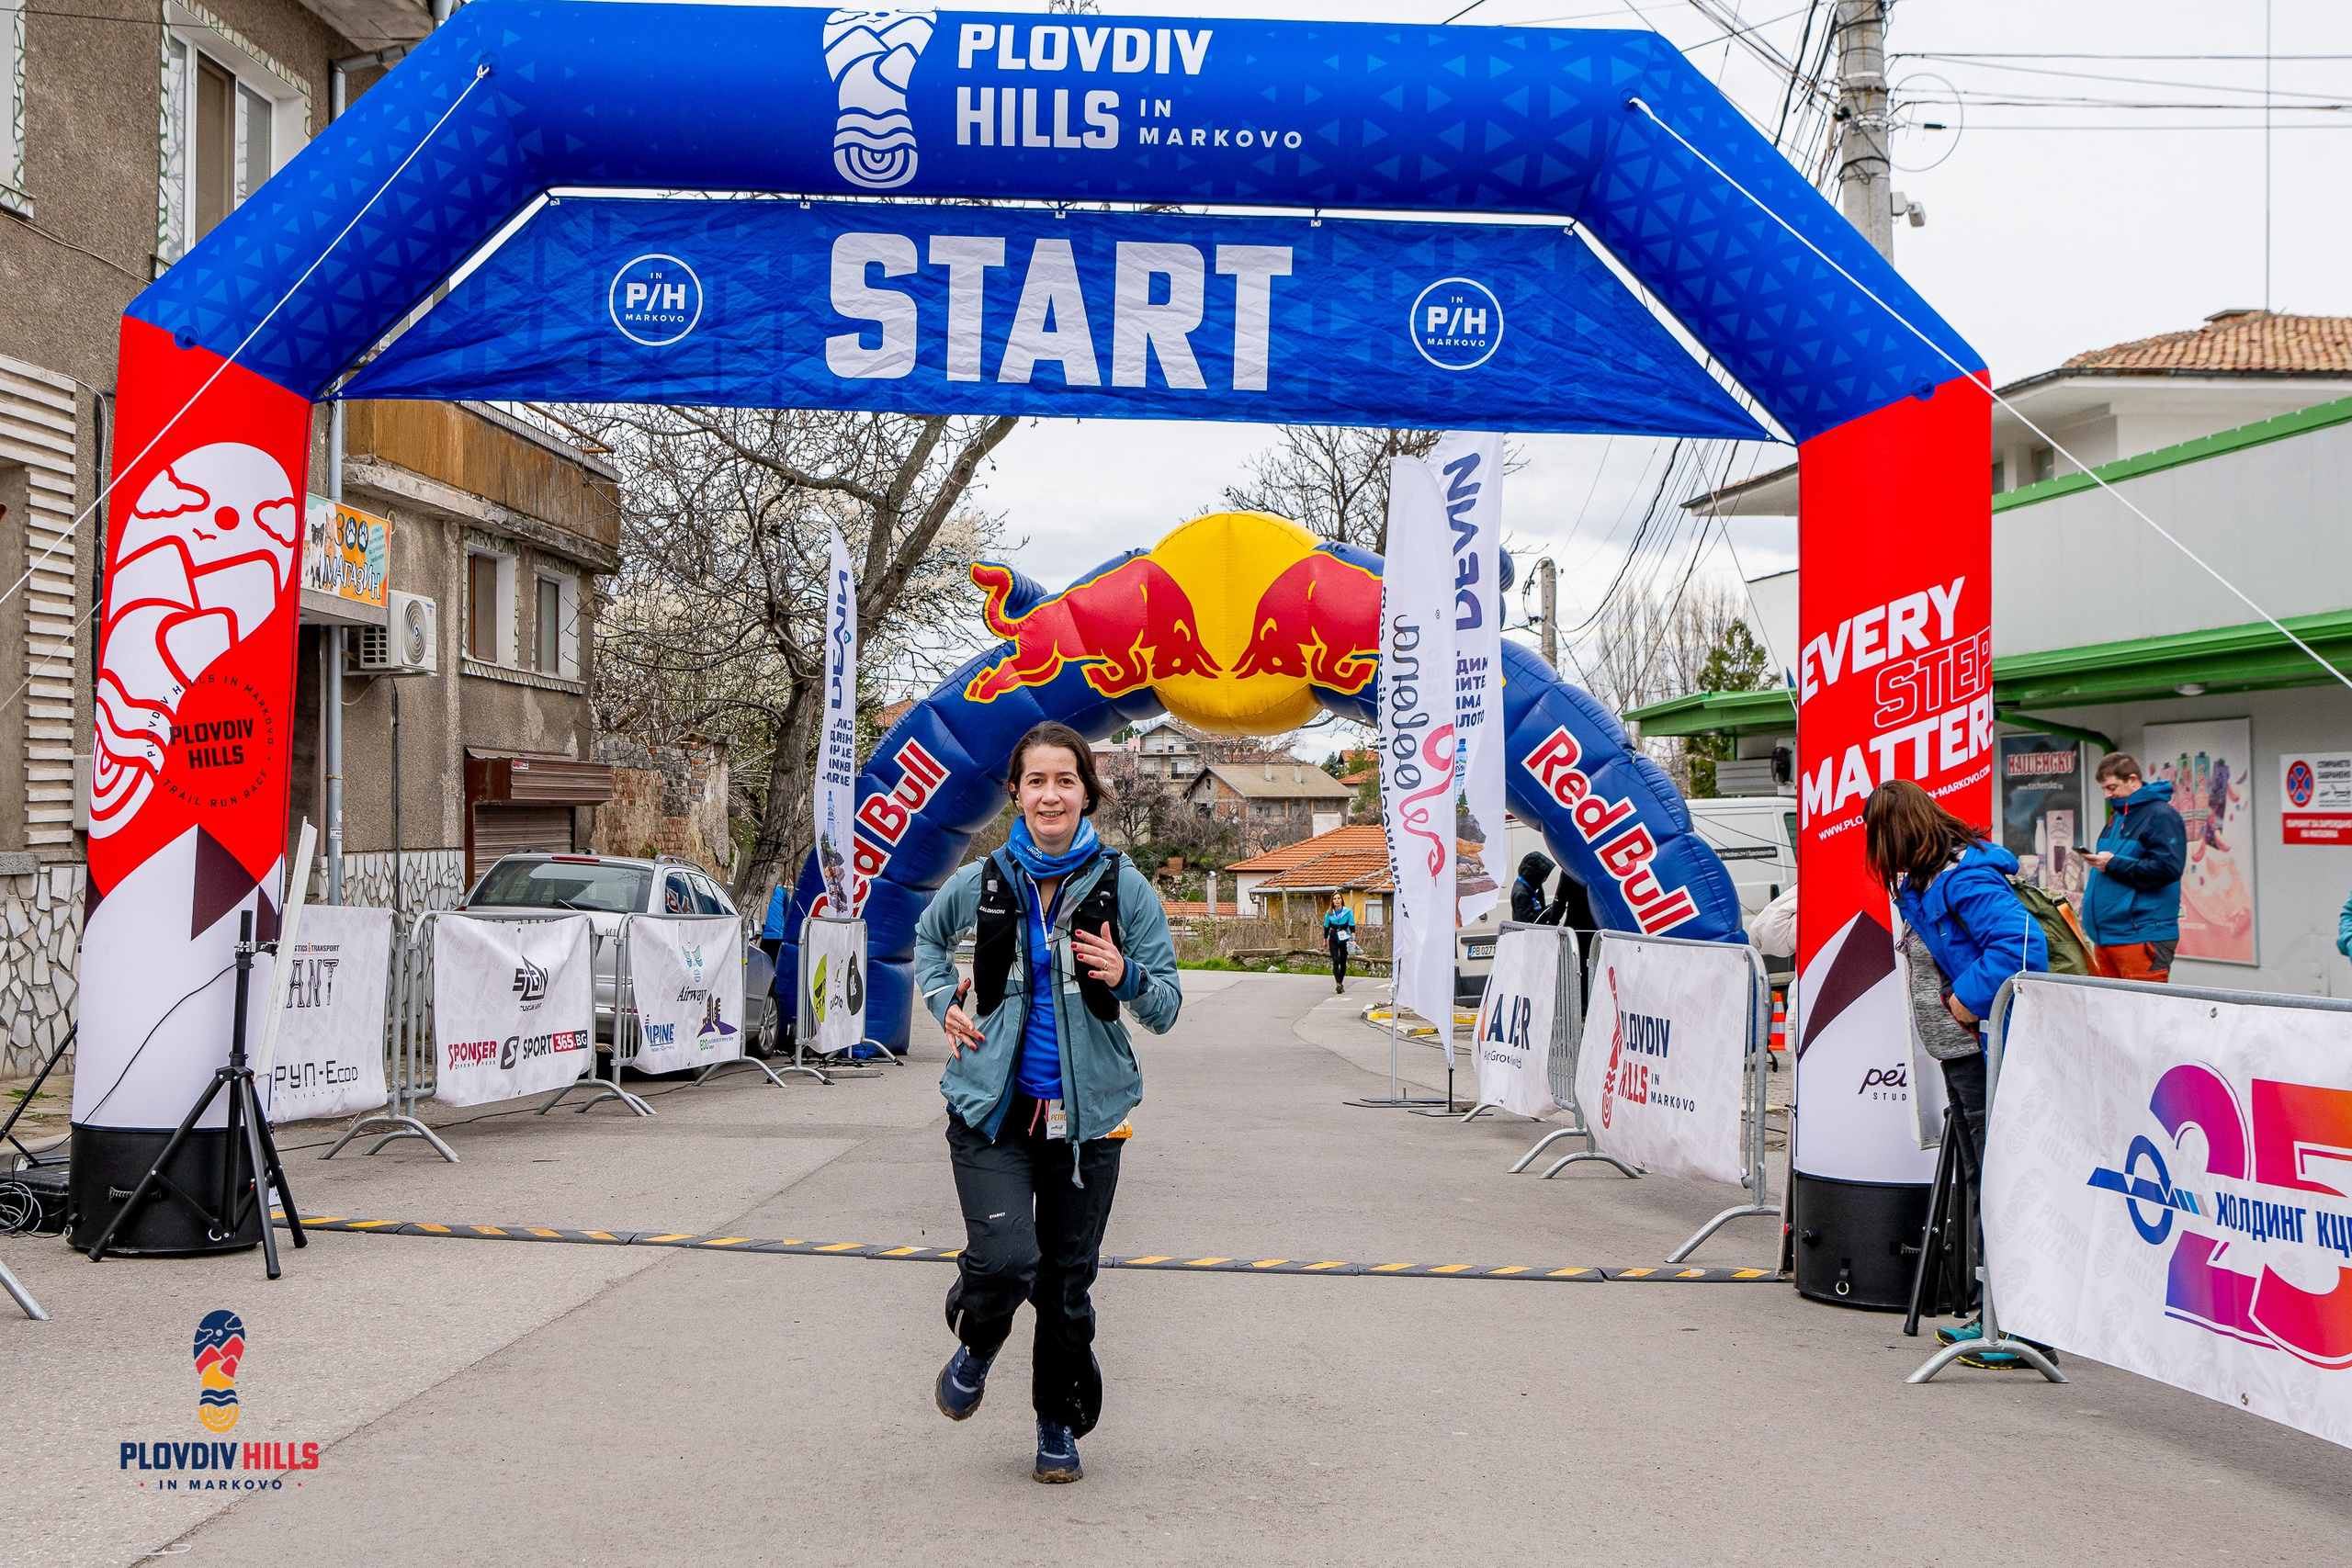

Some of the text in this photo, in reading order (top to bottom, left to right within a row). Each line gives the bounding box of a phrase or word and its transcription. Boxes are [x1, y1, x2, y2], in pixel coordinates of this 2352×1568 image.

[957, 24, 1213, 74] PLOVDIV
[956, 86, 1119, 149] HILLS
[1138, 98, 1171, 118] IN
[1138, 127, 1303, 149] MARKOVO
[626, 282, 686, 311] P/H
[825, 231, 1294, 391] START
[1451, 296, 1464, 304] IN
[625, 313, 684, 322] MARKOVO
[1427, 306, 1487, 336] P/H
[1427, 337, 1486, 347] MARKOVO
[324, 554, 381, 600] МАГАЗИН
[1801, 575, 1965, 706] EVERY
[1874, 626, 1991, 728] STEP
[146, 674, 274, 758] PLOVDIV HILLS IN MARKOVO
[169, 718, 254, 746] PLOVDIV
[187, 745, 244, 770] HILLS
[163, 770, 267, 808] TRAIL RUN RACE
[856, 739, 948, 845] Bull
[1525, 728, 1697, 935] Red Bull
[978, 906, 1006, 914] SALOMON
[311, 944, 340, 953] TRANSPORT
[447, 1040, 497, 1071] SPONSER
[1651, 1073, 1660, 1086] IN
[1650, 1090, 1695, 1112] MARKOVO
[1872, 1092, 1907, 1100] STUD
[2215, 1191, 2352, 1259] ХОЛДИНГ КЦ
